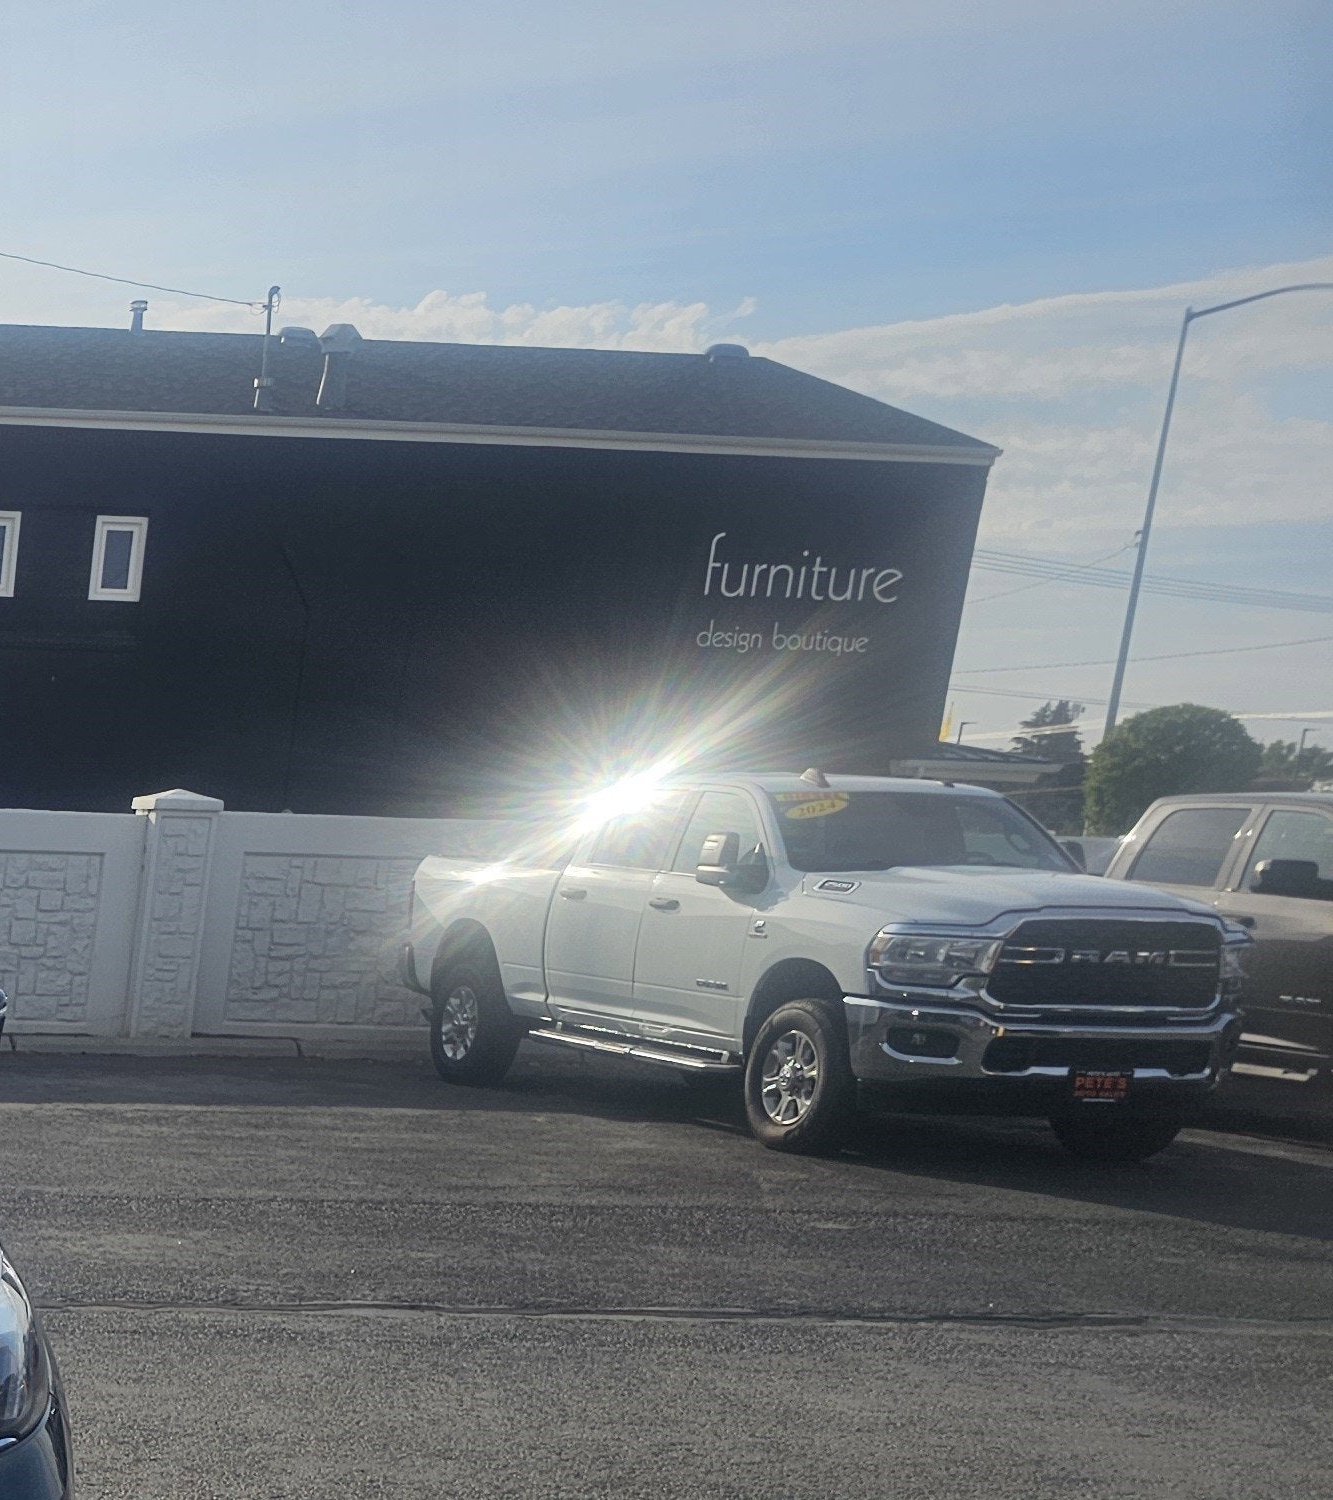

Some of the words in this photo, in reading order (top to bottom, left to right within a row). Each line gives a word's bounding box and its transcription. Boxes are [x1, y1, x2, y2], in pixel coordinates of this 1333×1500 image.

[703, 532, 903, 603] furniture
[696, 619, 762, 653] design
[771, 621, 869, 656] boutique
